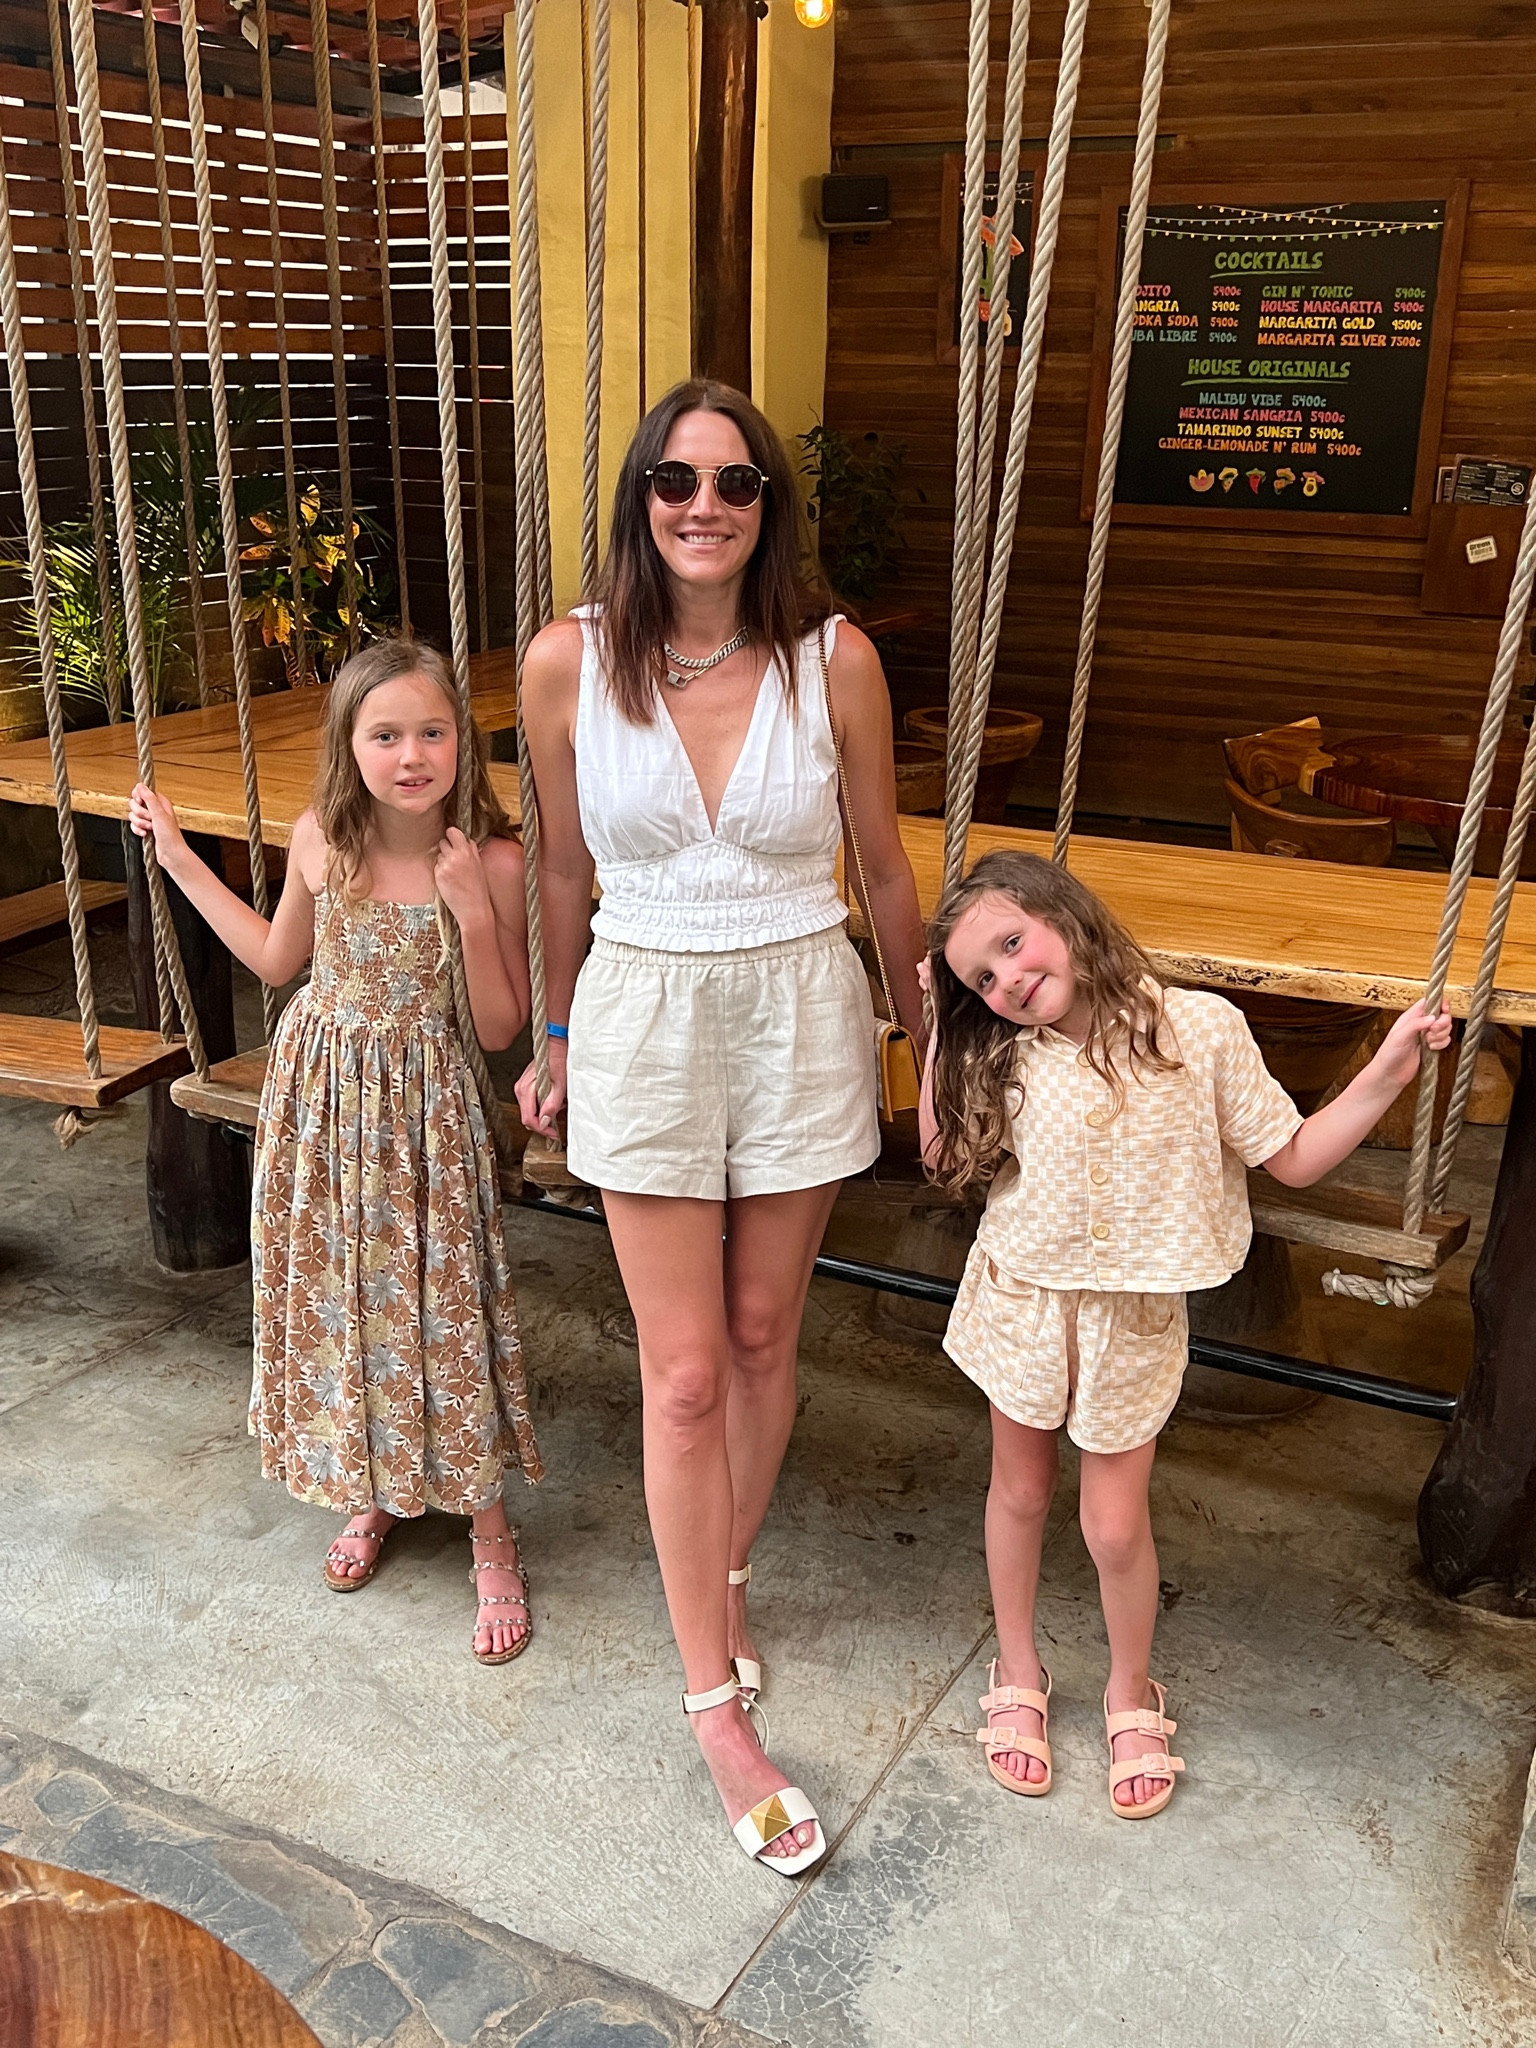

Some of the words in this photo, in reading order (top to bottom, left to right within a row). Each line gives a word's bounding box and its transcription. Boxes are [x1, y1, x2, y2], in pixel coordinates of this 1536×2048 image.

[1214, 251, 1324, 270] COCKTAILS
[1136, 285, 1172, 297] OJITO
[1212, 286, 1242, 297] 5900c
[1262, 285, 1287, 298] GIN
[1291, 285, 1305, 298] N'
[1311, 285, 1354, 298] TONIC
[1134, 300, 1180, 312] ANGRIA
[1211, 301, 1241, 312] 5900c
[1260, 300, 1300, 313] HOUSE
[1303, 300, 1383, 314] MARGARITA
[1393, 301, 1425, 313] 5900c
[1132, 314, 1162, 327] ODKA
[1167, 315, 1199, 327] SODA
[1210, 316, 1239, 328] 5900c
[1259, 316, 1338, 330] MARGARITA
[1342, 317, 1376, 330] GOLD
[1391, 319, 1423, 331] 9500c
[1131, 329, 1155, 342] UBA
[1159, 330, 1198, 342] LIBRE
[1208, 331, 1238, 343] 5400c
[1257, 332, 1336, 346] MARGARITA
[1340, 333, 1387, 347] SILVER
[1390, 336, 1421, 347] 7500c
[1187, 358, 1242, 376] HOUSE
[1248, 359, 1351, 378] ORIGINALS
[1199, 392, 1247, 406] MALIBU
[1251, 393, 1283, 407] VIBE
[1291, 394, 1328, 408] 5400c
[1179, 407, 1239, 421] MEXICAN
[1243, 409, 1303, 423] SANGRIA
[1310, 410, 1346, 424] 5900c
[1177, 423, 1252, 437] TAMARINDO
[1256, 425, 1303, 439] SUNSET
[1309, 426, 1345, 440] 5400c
[1158, 437, 1270, 452] GINGER-LEMONADE
[1273, 441, 1287, 454] N'
[1291, 441, 1317, 455] RUM
[1327, 443, 1363, 456] 5900c
